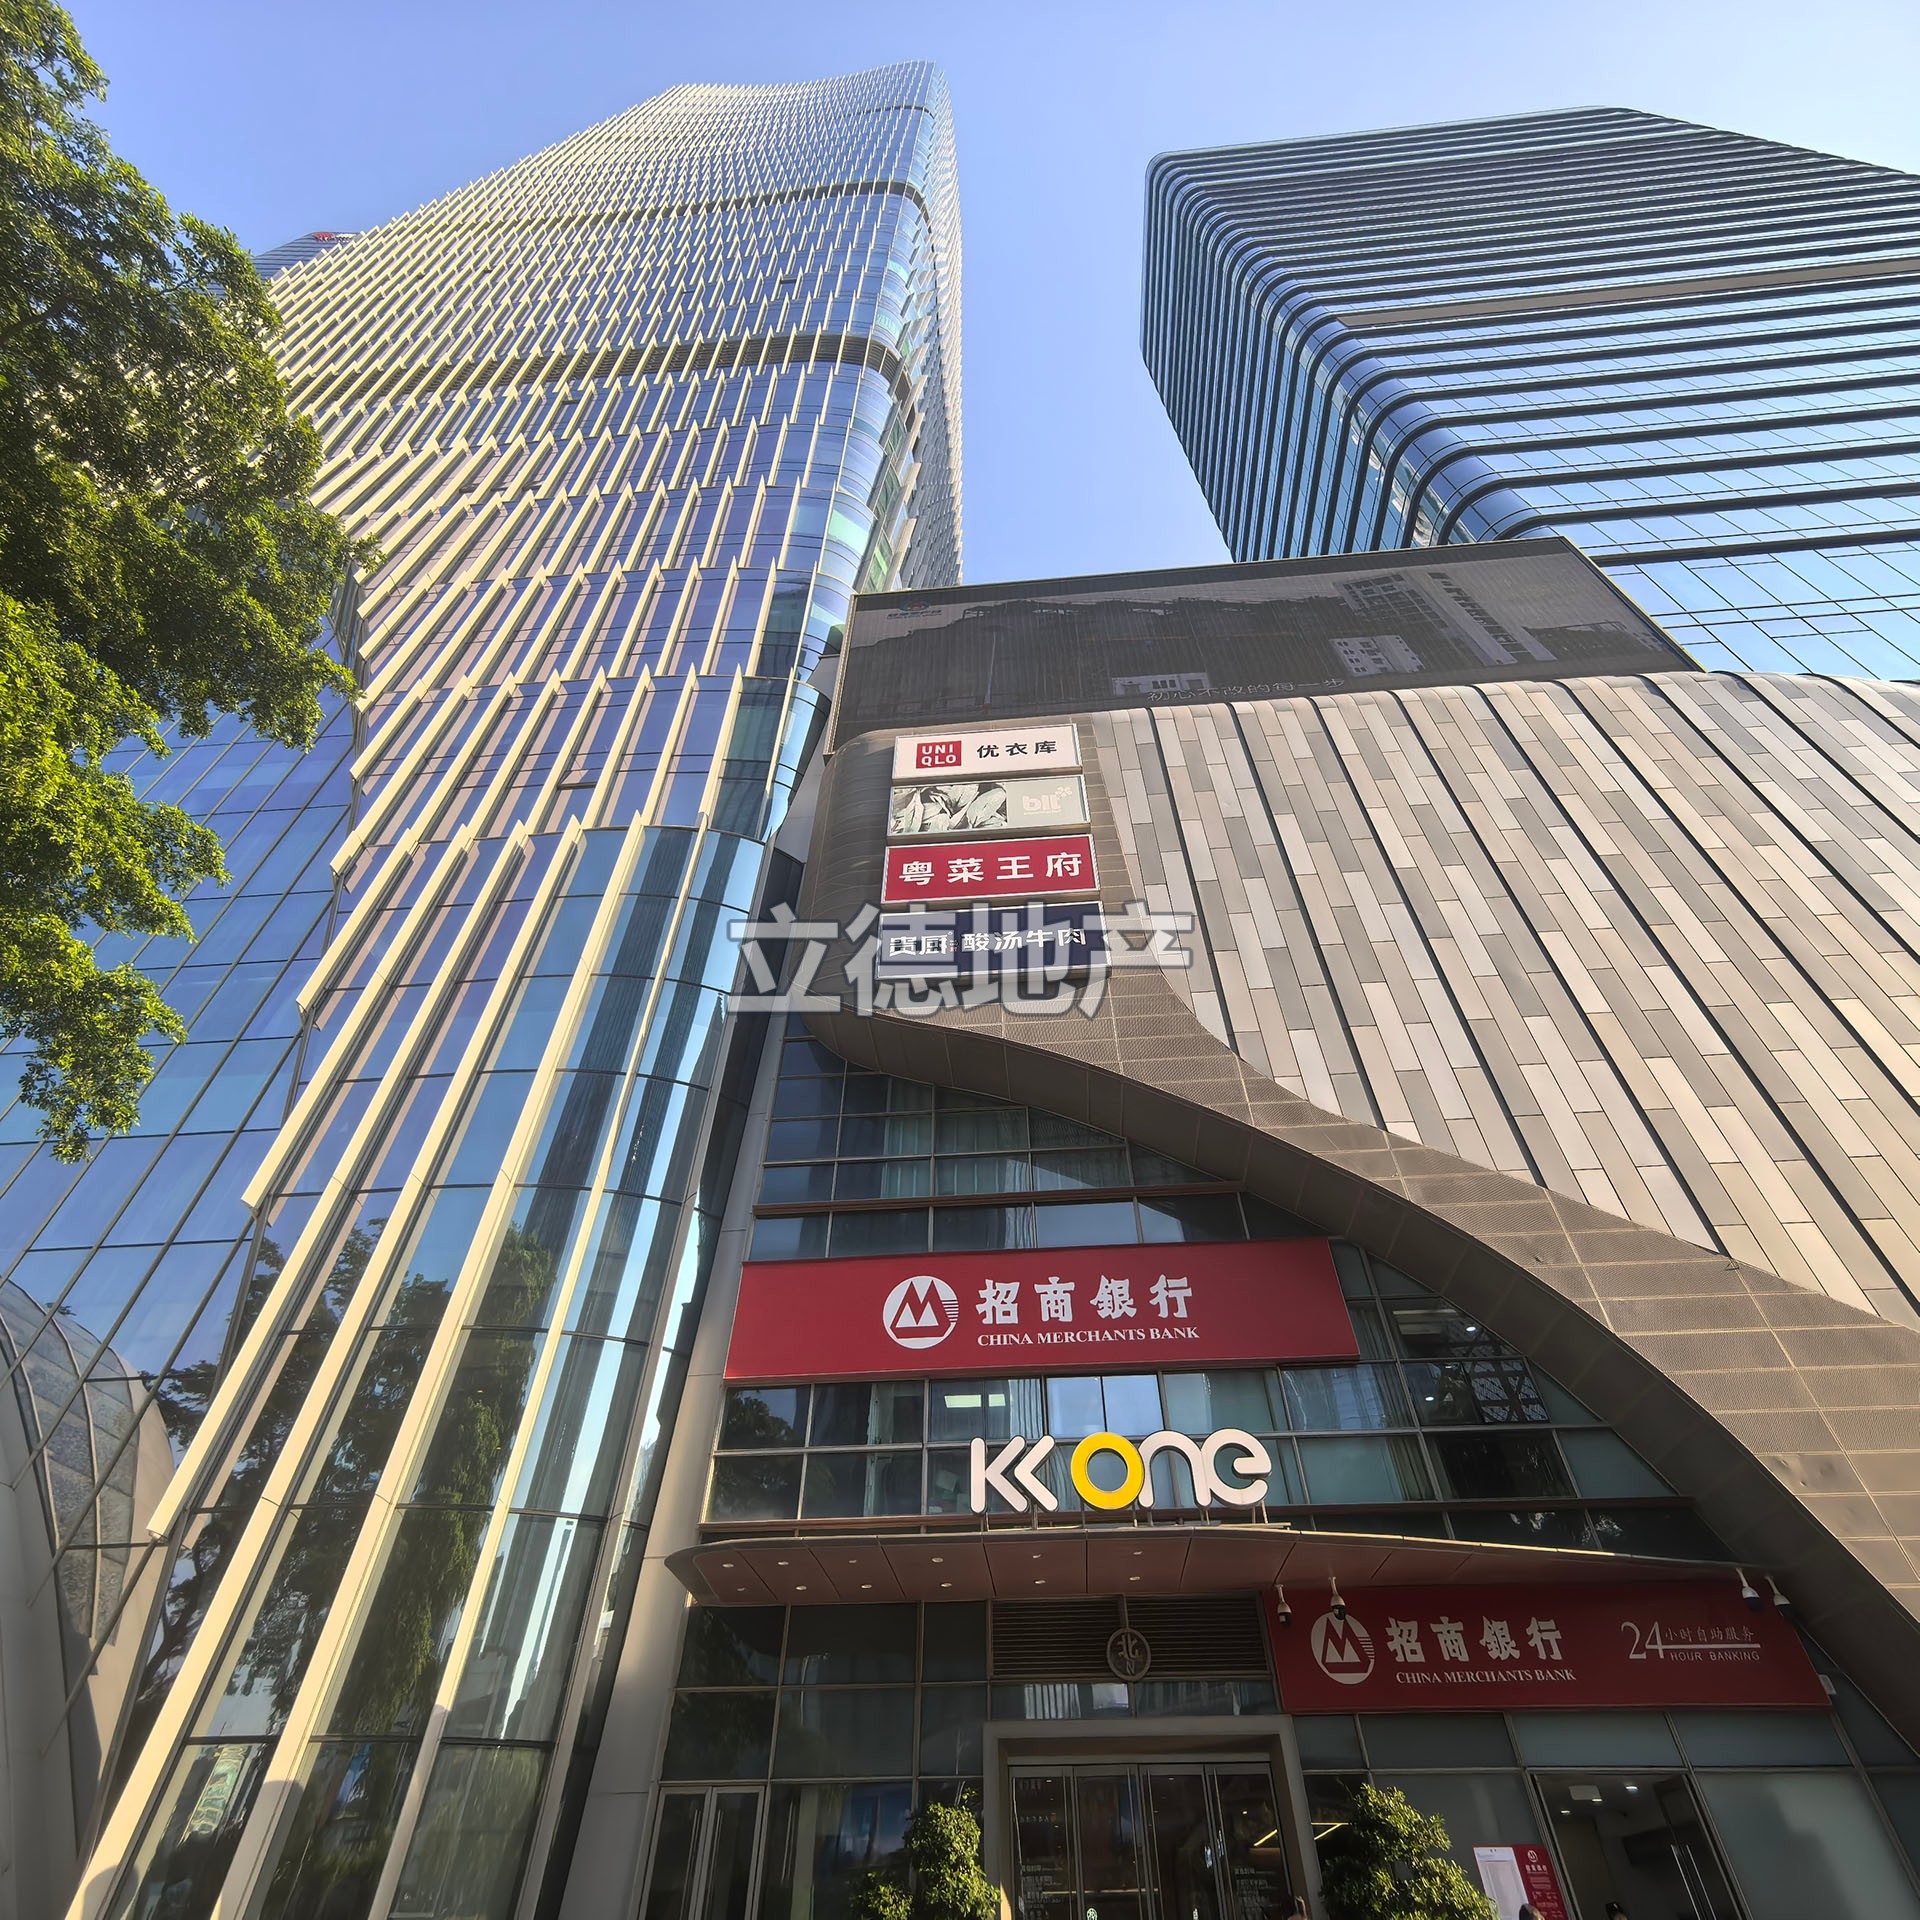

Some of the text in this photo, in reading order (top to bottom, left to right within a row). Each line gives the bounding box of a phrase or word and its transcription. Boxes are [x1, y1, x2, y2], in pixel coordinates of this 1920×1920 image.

[921, 743, 954, 755] UNI
[976, 740, 1057, 758] 优衣库
[921, 753, 957, 767] QLO
[899, 851, 1083, 886] 粤菜王府
[889, 934, 948, 957] 贵厨
[961, 928, 1086, 953] 酸汤牛肉
[975, 1273, 1194, 1325] 招商銀行
[977, 1326, 1200, 1347] CHINA MERCHANTS BANK
[1386, 1615, 1564, 1663] 招商銀行
[1620, 1621, 1665, 1660] 24
[1665, 1625, 1755, 1642] 小时自助服务
[1118, 1633, 1139, 1660] 北
[1670, 1651, 1760, 1661] HOUR BANKING
[1126, 1660, 1135, 1675] N
[1396, 1668, 1577, 1684] CHINA MERCHANTS BANK
